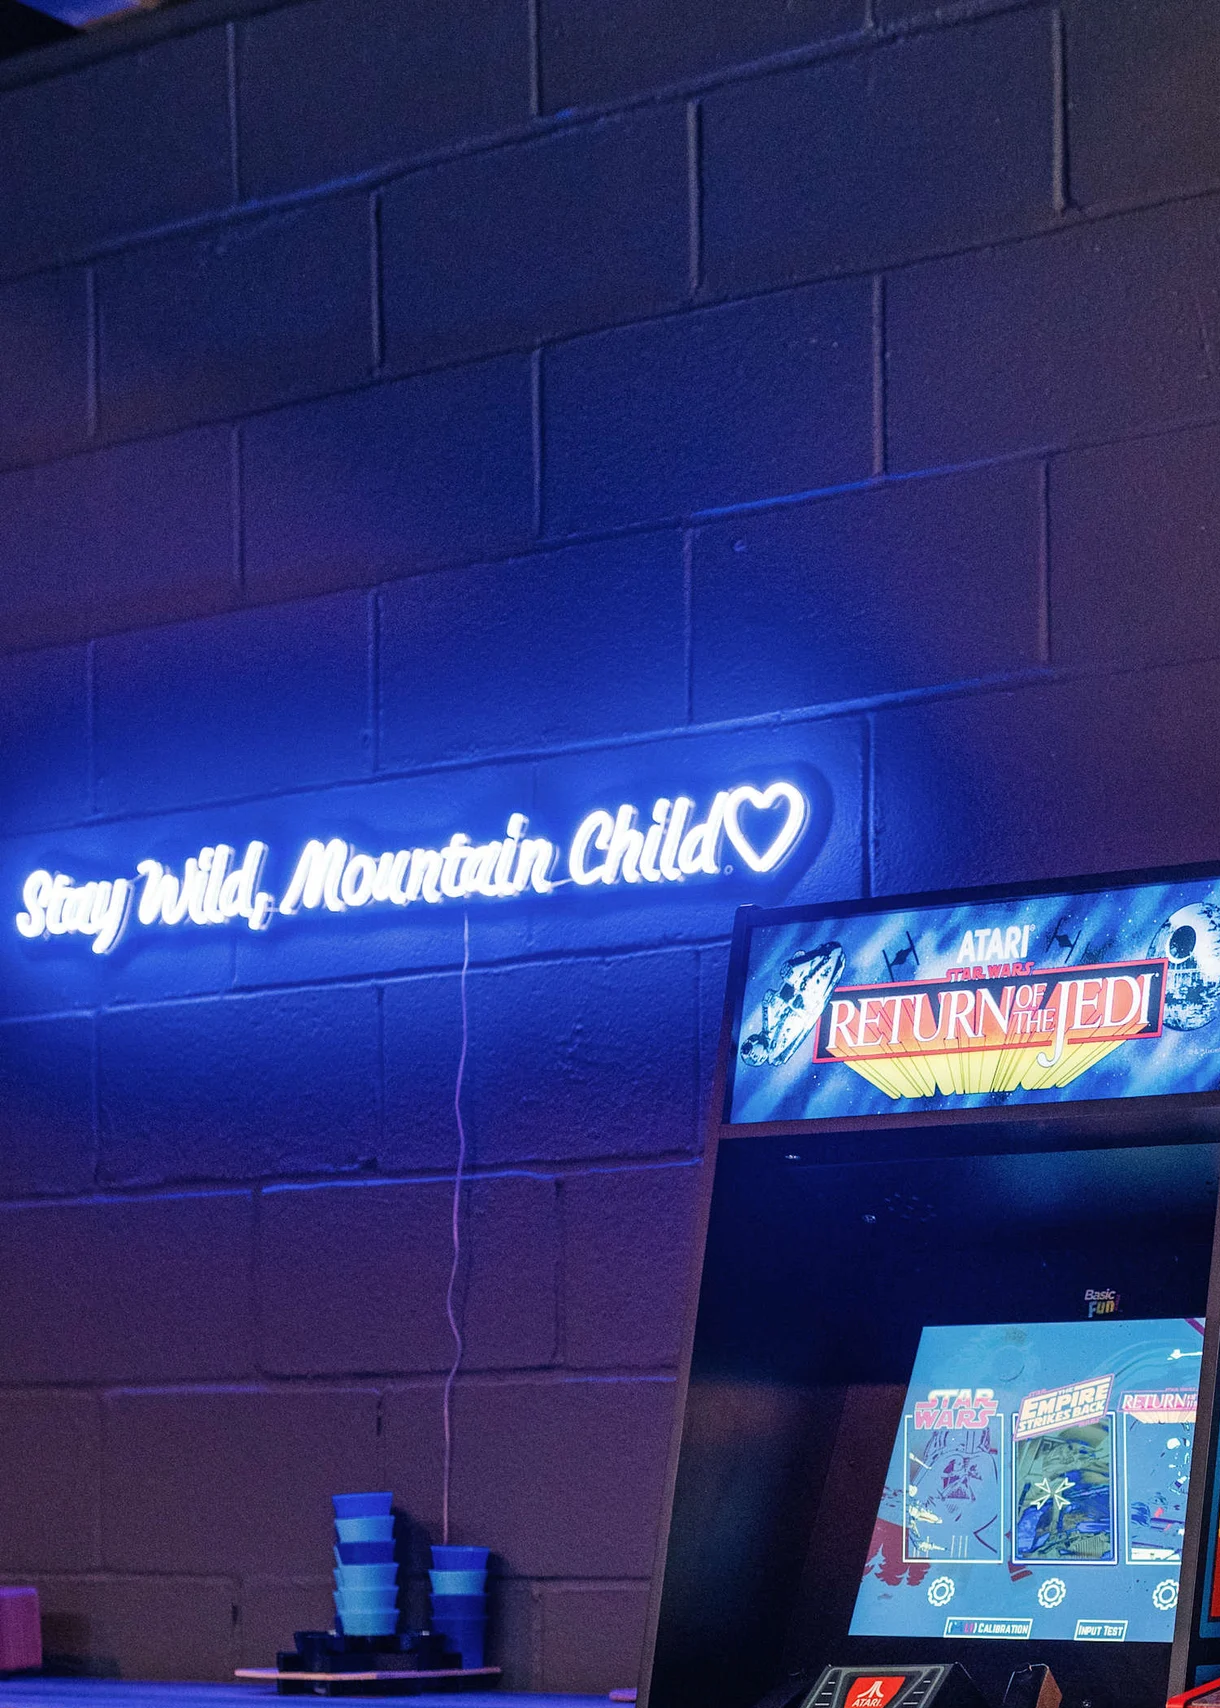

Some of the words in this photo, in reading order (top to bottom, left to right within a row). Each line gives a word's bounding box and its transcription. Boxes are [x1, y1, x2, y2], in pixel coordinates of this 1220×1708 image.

[15, 868, 132, 955] Stay
[137, 840, 271, 931] Wild,
[282, 812, 556, 915] Mountain
[567, 792, 730, 887] Child
[957, 924, 1029, 962] ATARI
[945, 967, 985, 983] STAR
[987, 961, 1035, 979] WARS
[1015, 984, 1046, 1009] OF
[826, 984, 1015, 1050] RETURN
[1012, 1006, 1057, 1034] THE
[1036, 972, 1160, 1067] JEDI
[1084, 1288, 1116, 1301] Basic
[915, 1388, 999, 1409] STAR
[1020, 1382, 1109, 1421] EMPIRE
[1122, 1393, 1187, 1410] RETURN
[914, 1409, 996, 1430] WARS
[1017, 1408, 1071, 1433] STRIKES
[1072, 1400, 1106, 1418] BACK
[1079, 1625, 1102, 1636] INPUT
[1104, 1626, 1123, 1636] TEST
[851, 1698, 882, 1707] ATARI
